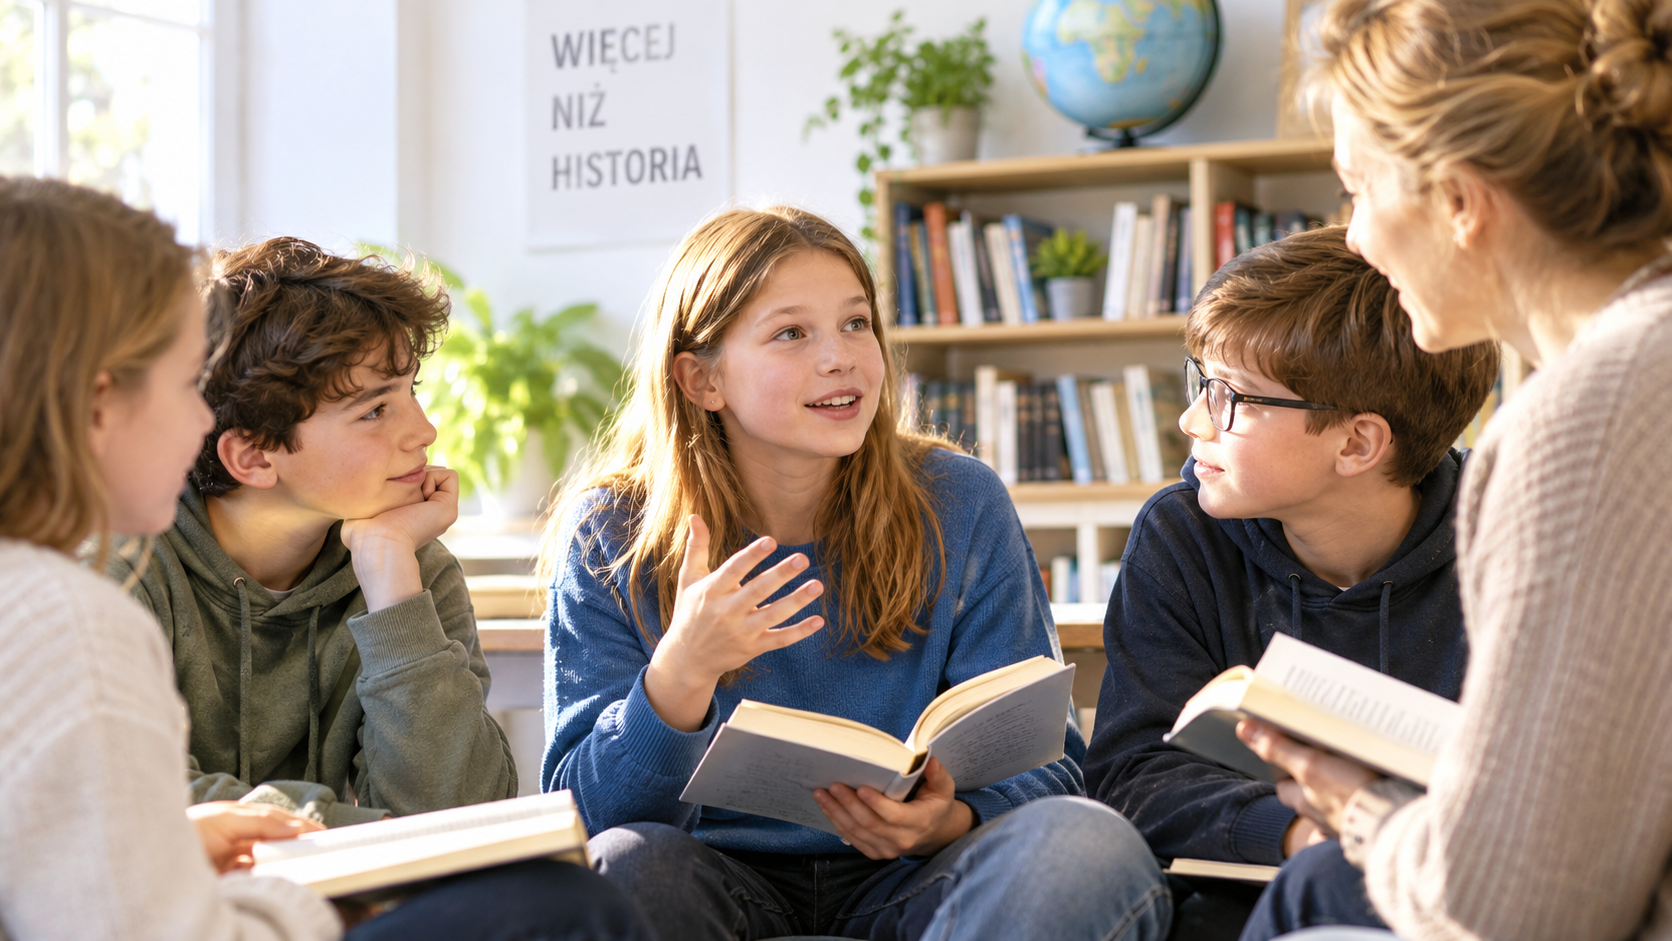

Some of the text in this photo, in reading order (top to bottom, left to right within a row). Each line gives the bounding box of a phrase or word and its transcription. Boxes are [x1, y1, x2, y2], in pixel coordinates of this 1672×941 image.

[551, 22, 675, 74] WIĘCEJ
[552, 81, 606, 131] NIŻ
[552, 144, 702, 191] HISTORIA
